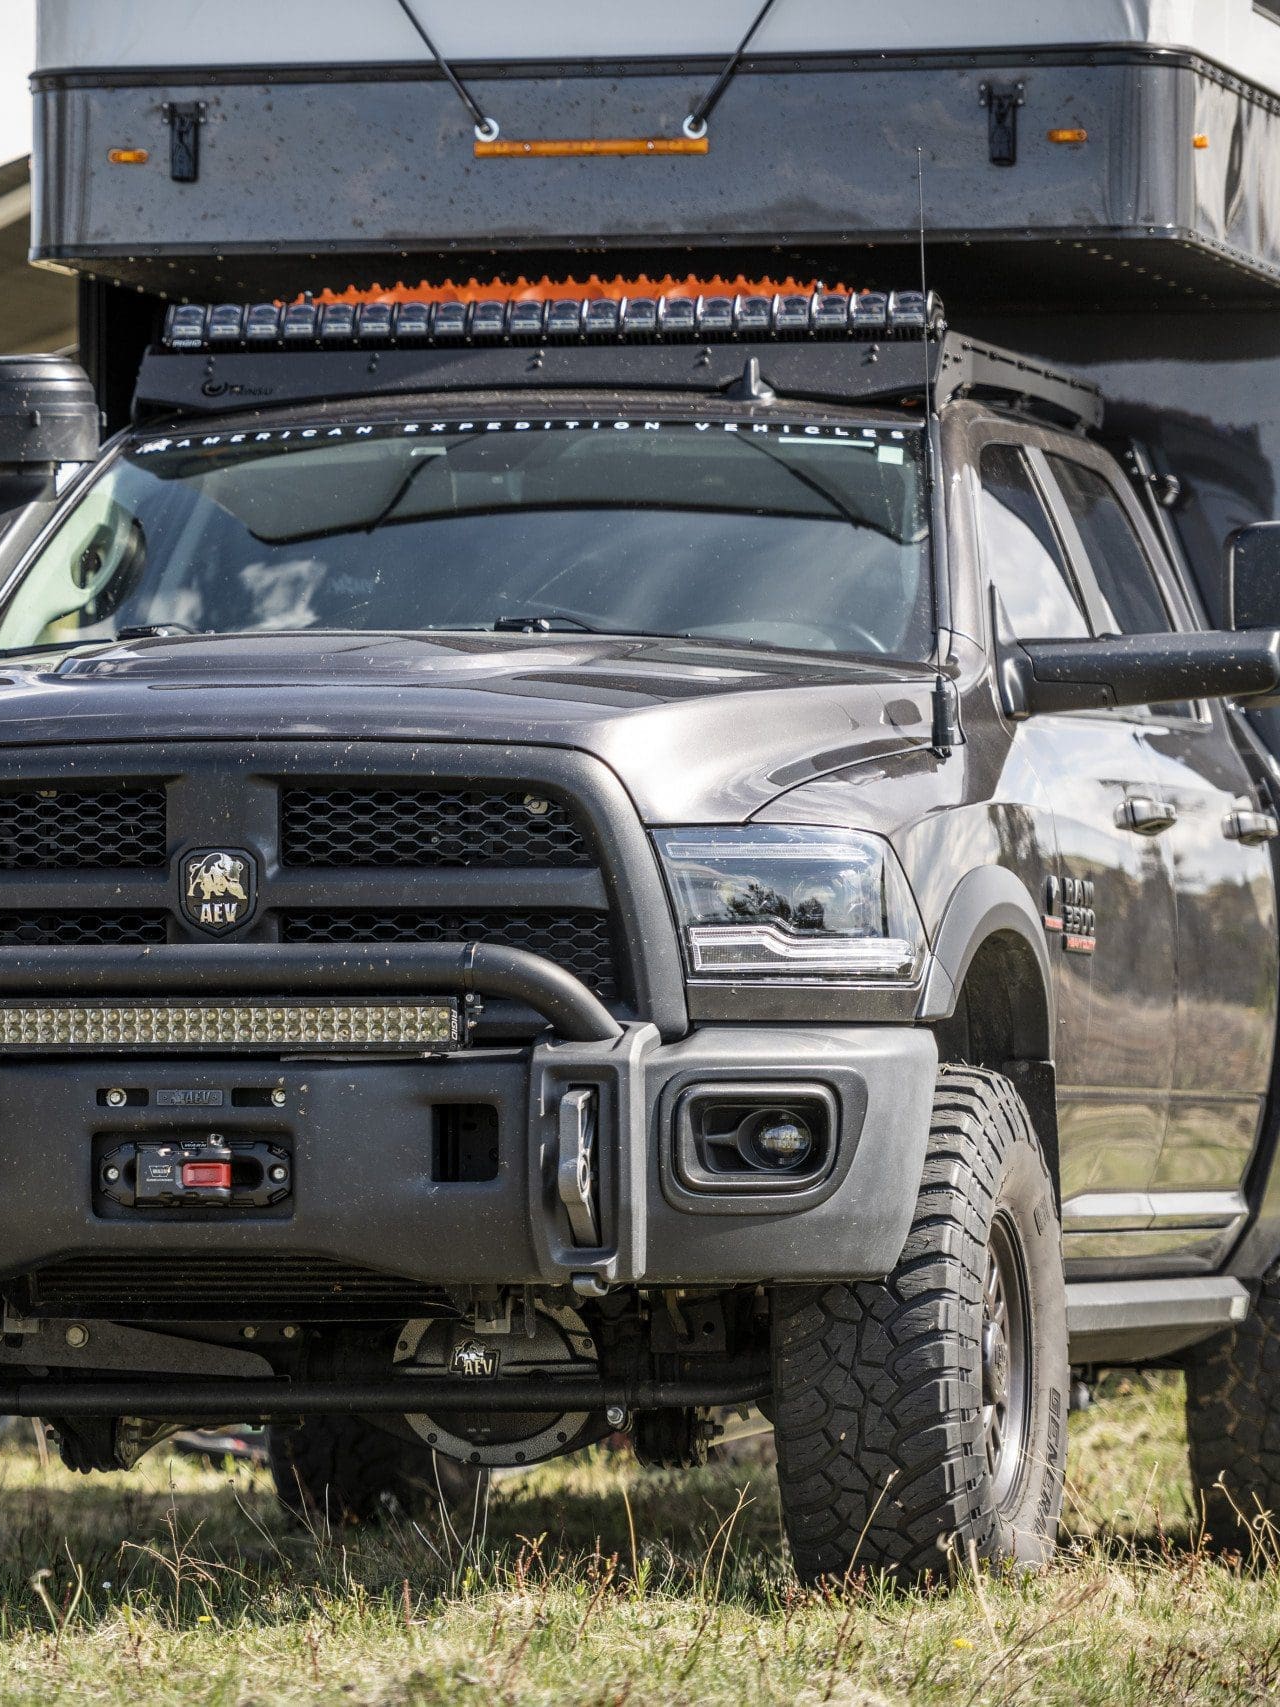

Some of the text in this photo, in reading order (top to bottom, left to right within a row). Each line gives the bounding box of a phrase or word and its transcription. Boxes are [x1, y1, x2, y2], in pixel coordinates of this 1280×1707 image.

[177, 421, 905, 449] AMERICAN EXPEDITION VEHICLES
[200, 902, 238, 923] AEV
[463, 1358, 494, 1376] AEV
